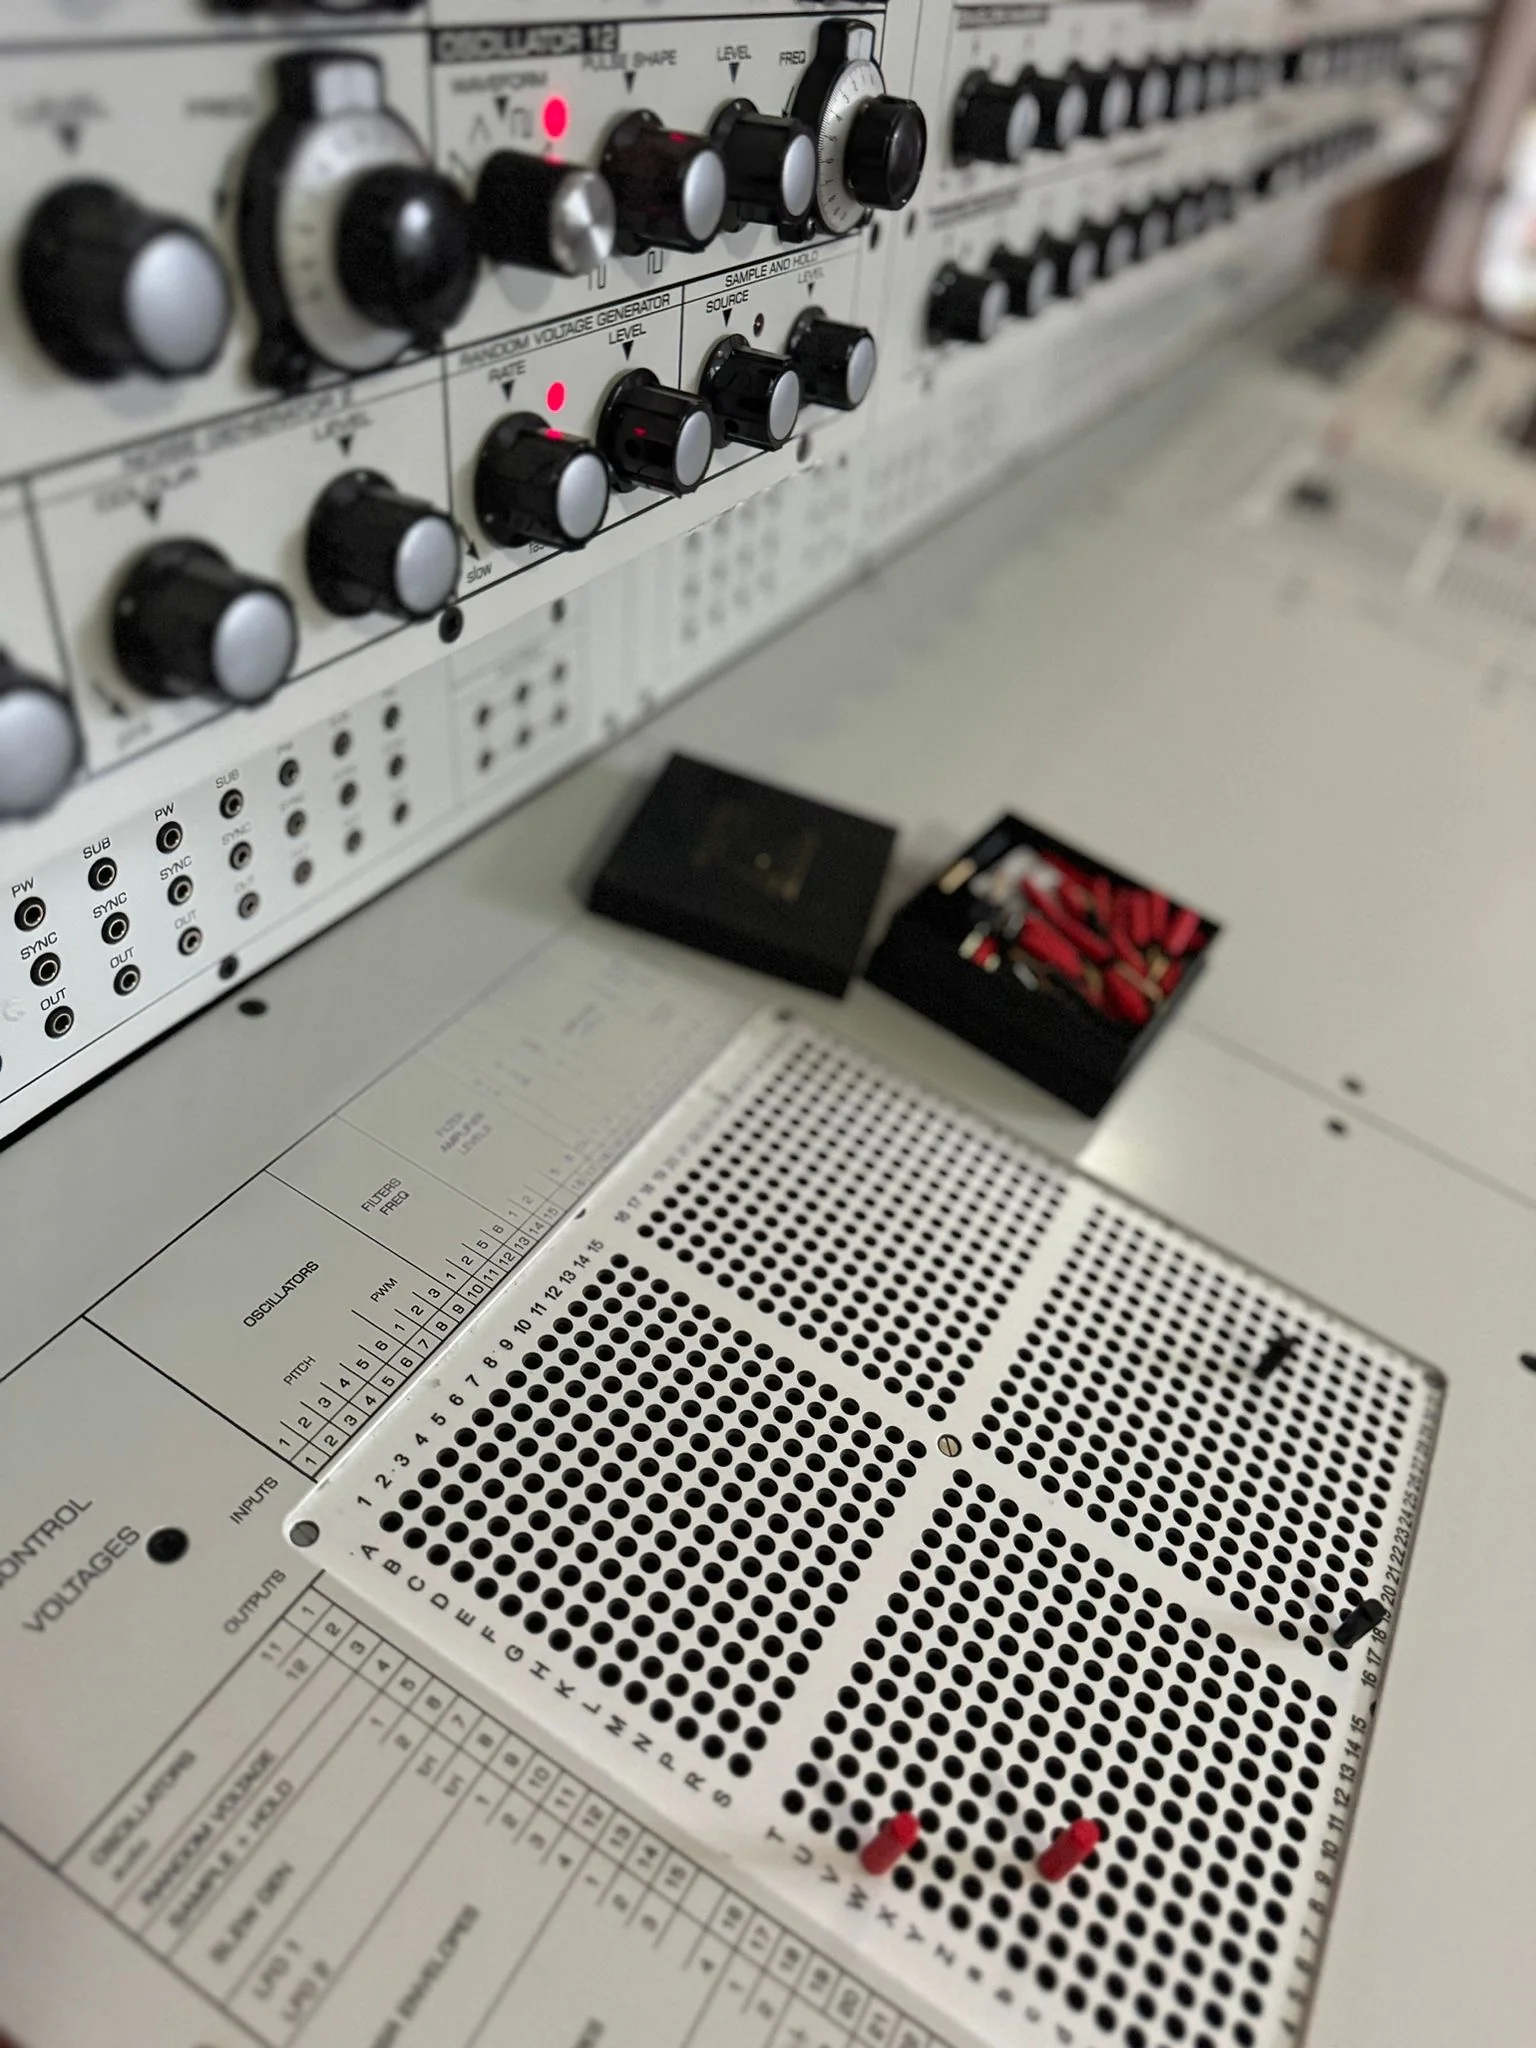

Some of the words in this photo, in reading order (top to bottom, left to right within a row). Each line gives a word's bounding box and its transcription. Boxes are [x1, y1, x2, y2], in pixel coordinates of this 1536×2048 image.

[632, 49, 677, 69] SHAPE
[717, 45, 752, 62] LEVEL
[725, 264, 767, 288] SAMPLE
[769, 257, 791, 274] AND
[706, 289, 749, 313] SOURCE
[533, 316, 594, 346] VOLTAGE
[596, 293, 671, 327] GENERATOR
[609, 323, 646, 344] LEVEL
[488, 360, 527, 383] RATE
[466, 561, 493, 584] slow
[215, 769, 240, 789] SUB
[154, 802, 176, 822] PW
[83, 836, 112, 860] SUB
[159, 855, 193, 881] SYNC
[11, 876, 36, 898] PW
[92, 891, 129, 919] SYNC
[174, 909, 198, 931] OUT
[20, 931, 59, 961] SYNC
[110, 946, 136, 970] OUT
[40, 987, 67, 1012] OUT
[361, 1177, 402, 1212] FILTERS
[379, 1189, 411, 1216] FREQ
[446, 1271, 457, 1281] 1
[461, 1255, 474, 1266] 2
[476, 1239, 489, 1250] 5
[243, 1260, 320, 1328] OSCILLATORS
[369, 1277, 399, 1303] PWM
[394, 1322, 406, 1332] 1
[411, 1304, 424, 1316] 2
[428, 1288, 441, 1299] 3
[305, 1456, 317, 1466] 1
[324, 1434, 338, 1447] 2
[344, 1414, 357, 1427] 3
[365, 1395, 377, 1406] 4
[381, 1375, 395, 1387] 5
[400, 1357, 413, 1368] 6
[417, 1339, 429, 1349] 7
[435, 1321, 448, 1332] 8
[452, 1304, 465, 1315] 9
[467, 1283, 485, 1300] 10
[483, 1268, 500, 1283] 11
[499, 1251, 516, 1266] 12
[514, 1236, 530, 1251] 13
[283, 1355, 317, 1386] PITCH
[357, 1494, 373, 1508] 1
[375, 1473, 392, 1490] 2
[394, 1453, 410, 1468] 3
[415, 1432, 429, 1447] 4
[431, 1412, 447, 1426] 5
[449, 1393, 464, 1406] 6
[465, 1374, 480, 1389] 7
[483, 1356, 498, 1369] 8
[499, 1338, 514, 1351] 9
[514, 1318, 532, 1335] 10
[531, 1302, 548, 1318] 11
[545, 1285, 563, 1301] 12
[559, 1269, 577, 1285] 13
[573, 1254, 591, 1270] 14
[588, 1238, 605, 1254] 15
[279, 1437, 291, 1447] 1
[298, 1416, 312, 1429] 2
[318, 1396, 332, 1408] 3
[339, 1377, 351, 1389] 4
[356, 1358, 370, 1370] 5
[375, 1340, 388, 1351] 6
[228, 1475, 279, 1525] INPUTS
[0, 1497, 93, 1592] ONTROL
[1394, 1526, 1411, 1548] 23
[1390, 1544, 1407, 1567] 22
[22, 1525, 141, 1634] VOLTAGES
[1385, 1564, 1402, 1586] 21
[223, 1568, 287, 1636] OUTPUTS
[1380, 1584, 1397, 1606] 20
[302, 1605, 316, 1617] 1
[325, 1622, 342, 1638] 2
[349, 1640, 365, 1655] 3
[1371, 1626, 1387, 1646] 18
[1366, 1646, 1382, 1667] 17
[361, 1543, 379, 1560] A
[382, 1558, 402, 1576] B
[407, 1575, 426, 1592] C
[430, 1592, 449, 1611] D
[454, 1608, 477, 1627] E
[480, 1625, 497, 1644] F
[504, 1644, 525, 1663] G
[529, 1660, 552, 1681] H
[554, 1678, 576, 1699] K
[581, 1702, 603, 1716] L
[603, 1714, 628, 1737] M
[631, 1732, 653, 1754] N
[658, 1751, 676, 1773] P
[683, 1771, 707, 1792] R
[712, 1789, 732, 1809] S
[1361, 1669, 1377, 1689] 16
[1350, 1713, 1368, 1735] 15
[1344, 1738, 1362, 1759] 14
[1338, 1762, 1357, 1784] 13
[1333, 1786, 1350, 1809] 12
[1327, 1812, 1345, 1833] 11
[1321, 1838, 1338, 1861] 10
[766, 1825, 786, 1845] T
[793, 1845, 813, 1867] U
[820, 1864, 841, 1887] V
[876, 1904, 898, 1929] X
